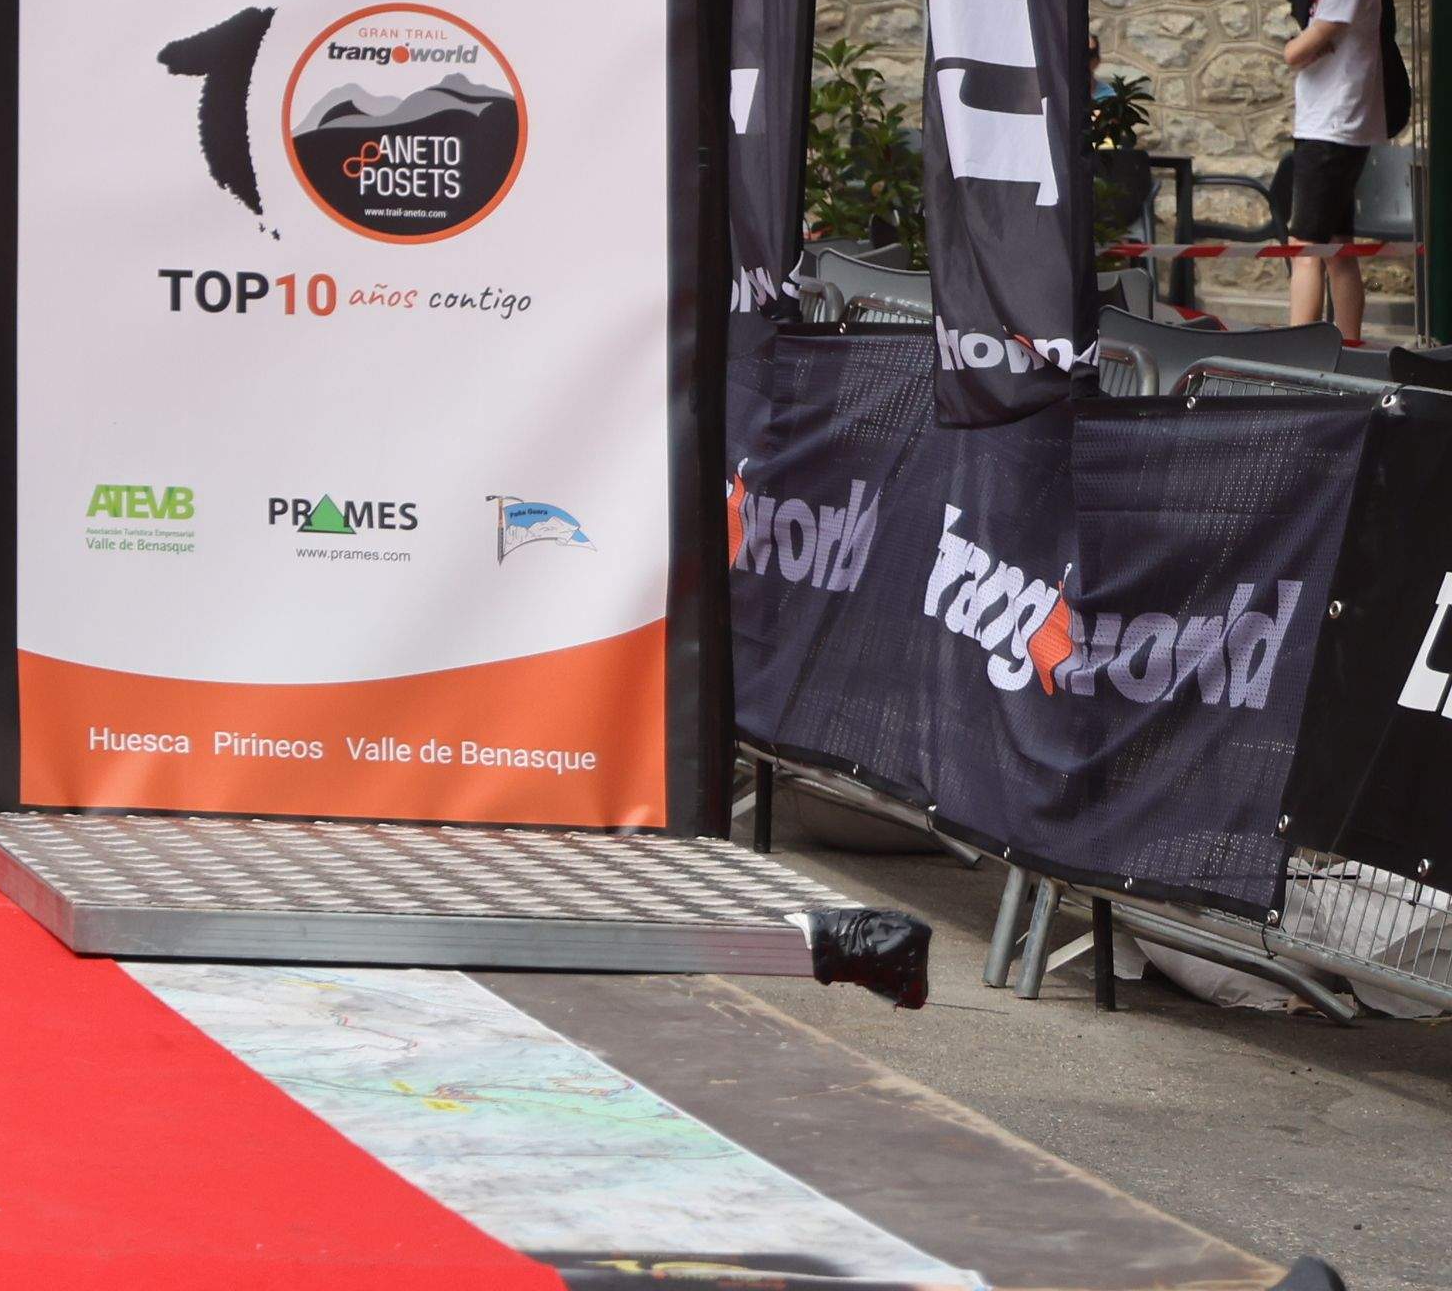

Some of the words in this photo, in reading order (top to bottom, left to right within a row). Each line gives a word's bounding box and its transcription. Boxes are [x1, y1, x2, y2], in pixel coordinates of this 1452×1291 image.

[358, 27, 399, 39] GRAN
[405, 27, 447, 41] TRAIL
[378, 135, 461, 167] ANETO
[359, 167, 461, 199] POSETS
[349, 283, 417, 309] años
[429, 288, 532, 319] contigo
[86, 484, 195, 521] ATEVB
[86, 536, 115, 550] Valle
[119, 537, 134, 551] de
[137, 538, 195, 555] Benasque
[296, 545, 411, 563] www.prames.com
[88, 727, 190, 754] Huesca
[213, 731, 324, 760] Pirineos
[346, 736, 411, 763] Valle
[419, 739, 453, 765] de
[461, 740, 596, 773] Benasque
